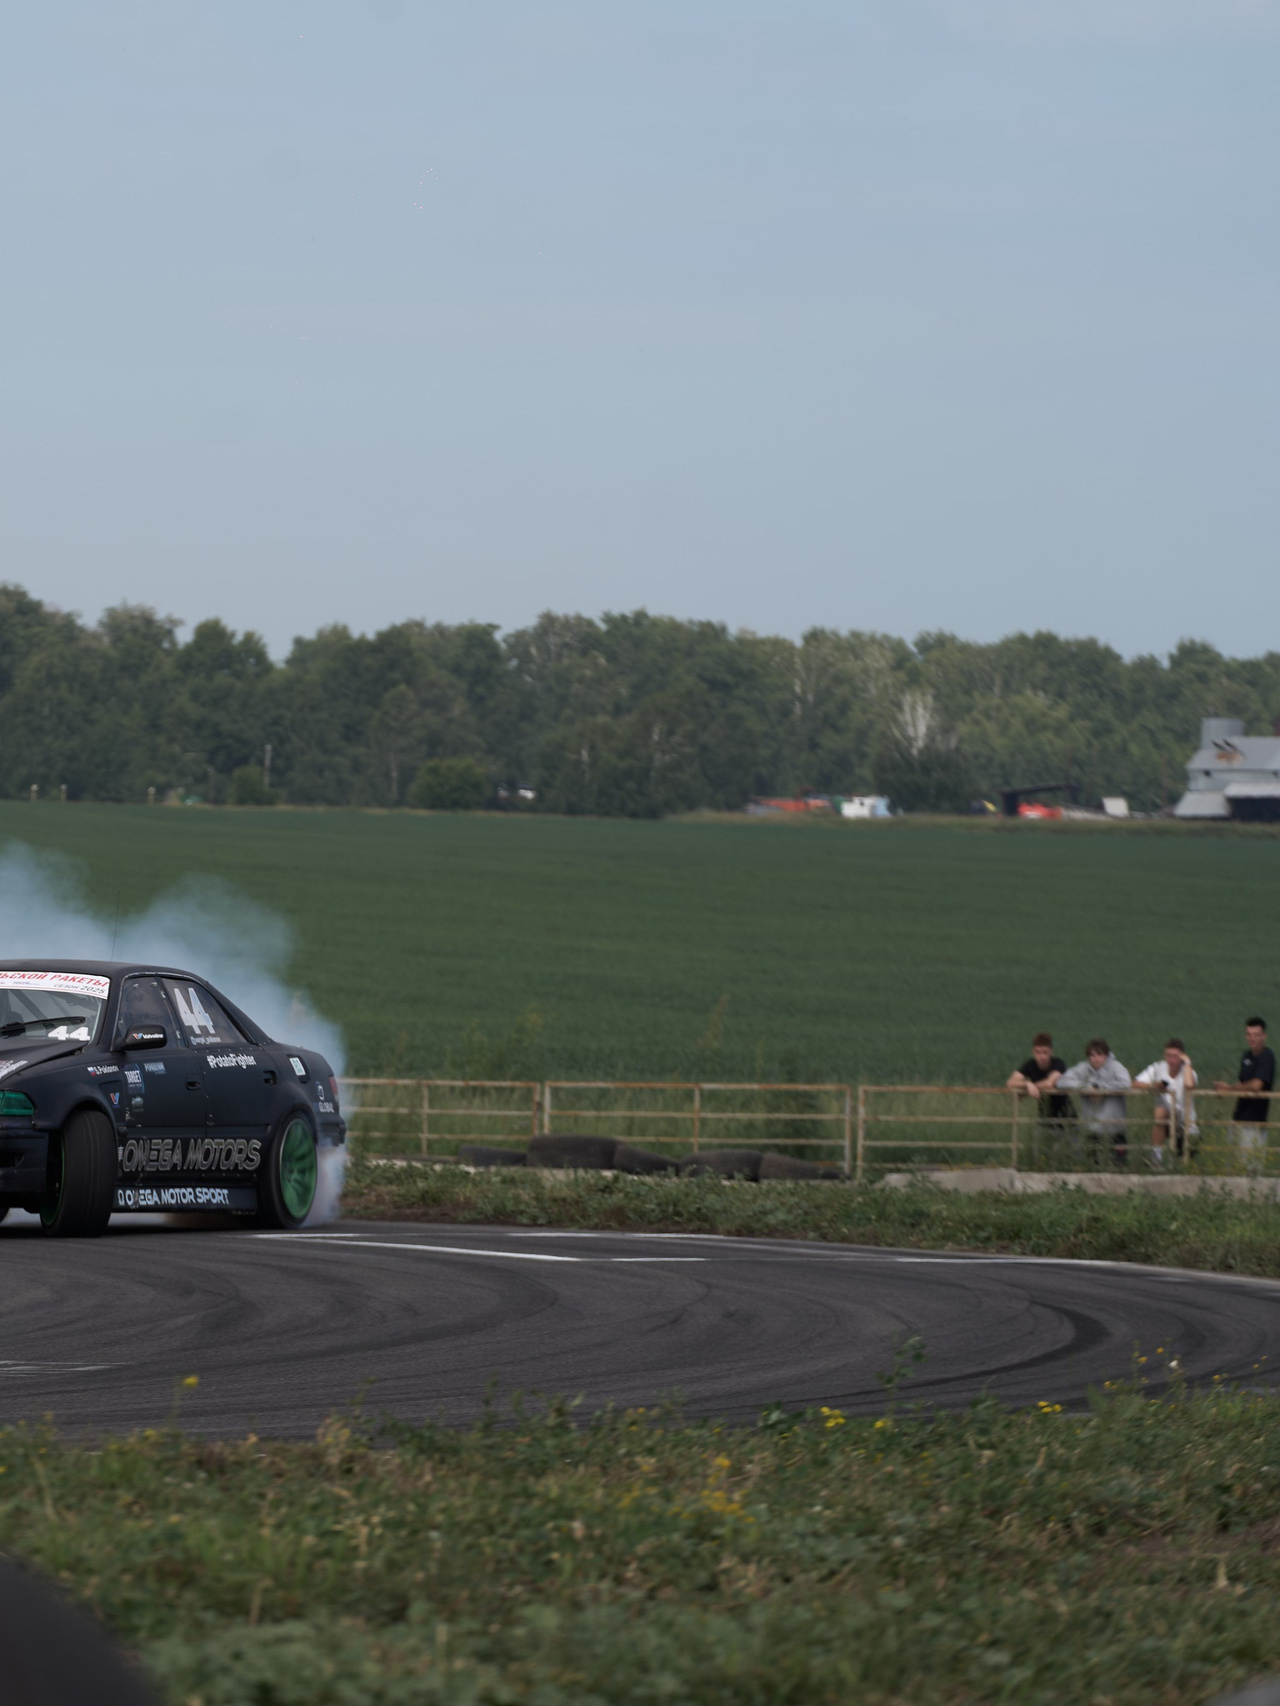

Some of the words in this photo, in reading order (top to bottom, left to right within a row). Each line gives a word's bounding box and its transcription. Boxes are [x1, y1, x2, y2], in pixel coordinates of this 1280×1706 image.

[50, 974, 109, 987] РАКЕТЫ
[80, 985, 105, 994] 2025
[173, 987, 216, 1034] 44
[48, 1025, 91, 1041] 44
[206, 1053, 257, 1069] #PotatoFighter
[124, 1070, 142, 1083] TARGET
[122, 1138, 183, 1172] OMEGA
[183, 1138, 262, 1171] MOTORS
[125, 1188, 160, 1206] OEGA
[161, 1188, 195, 1204] MOTOR
[196, 1187, 230, 1204] SPORT
